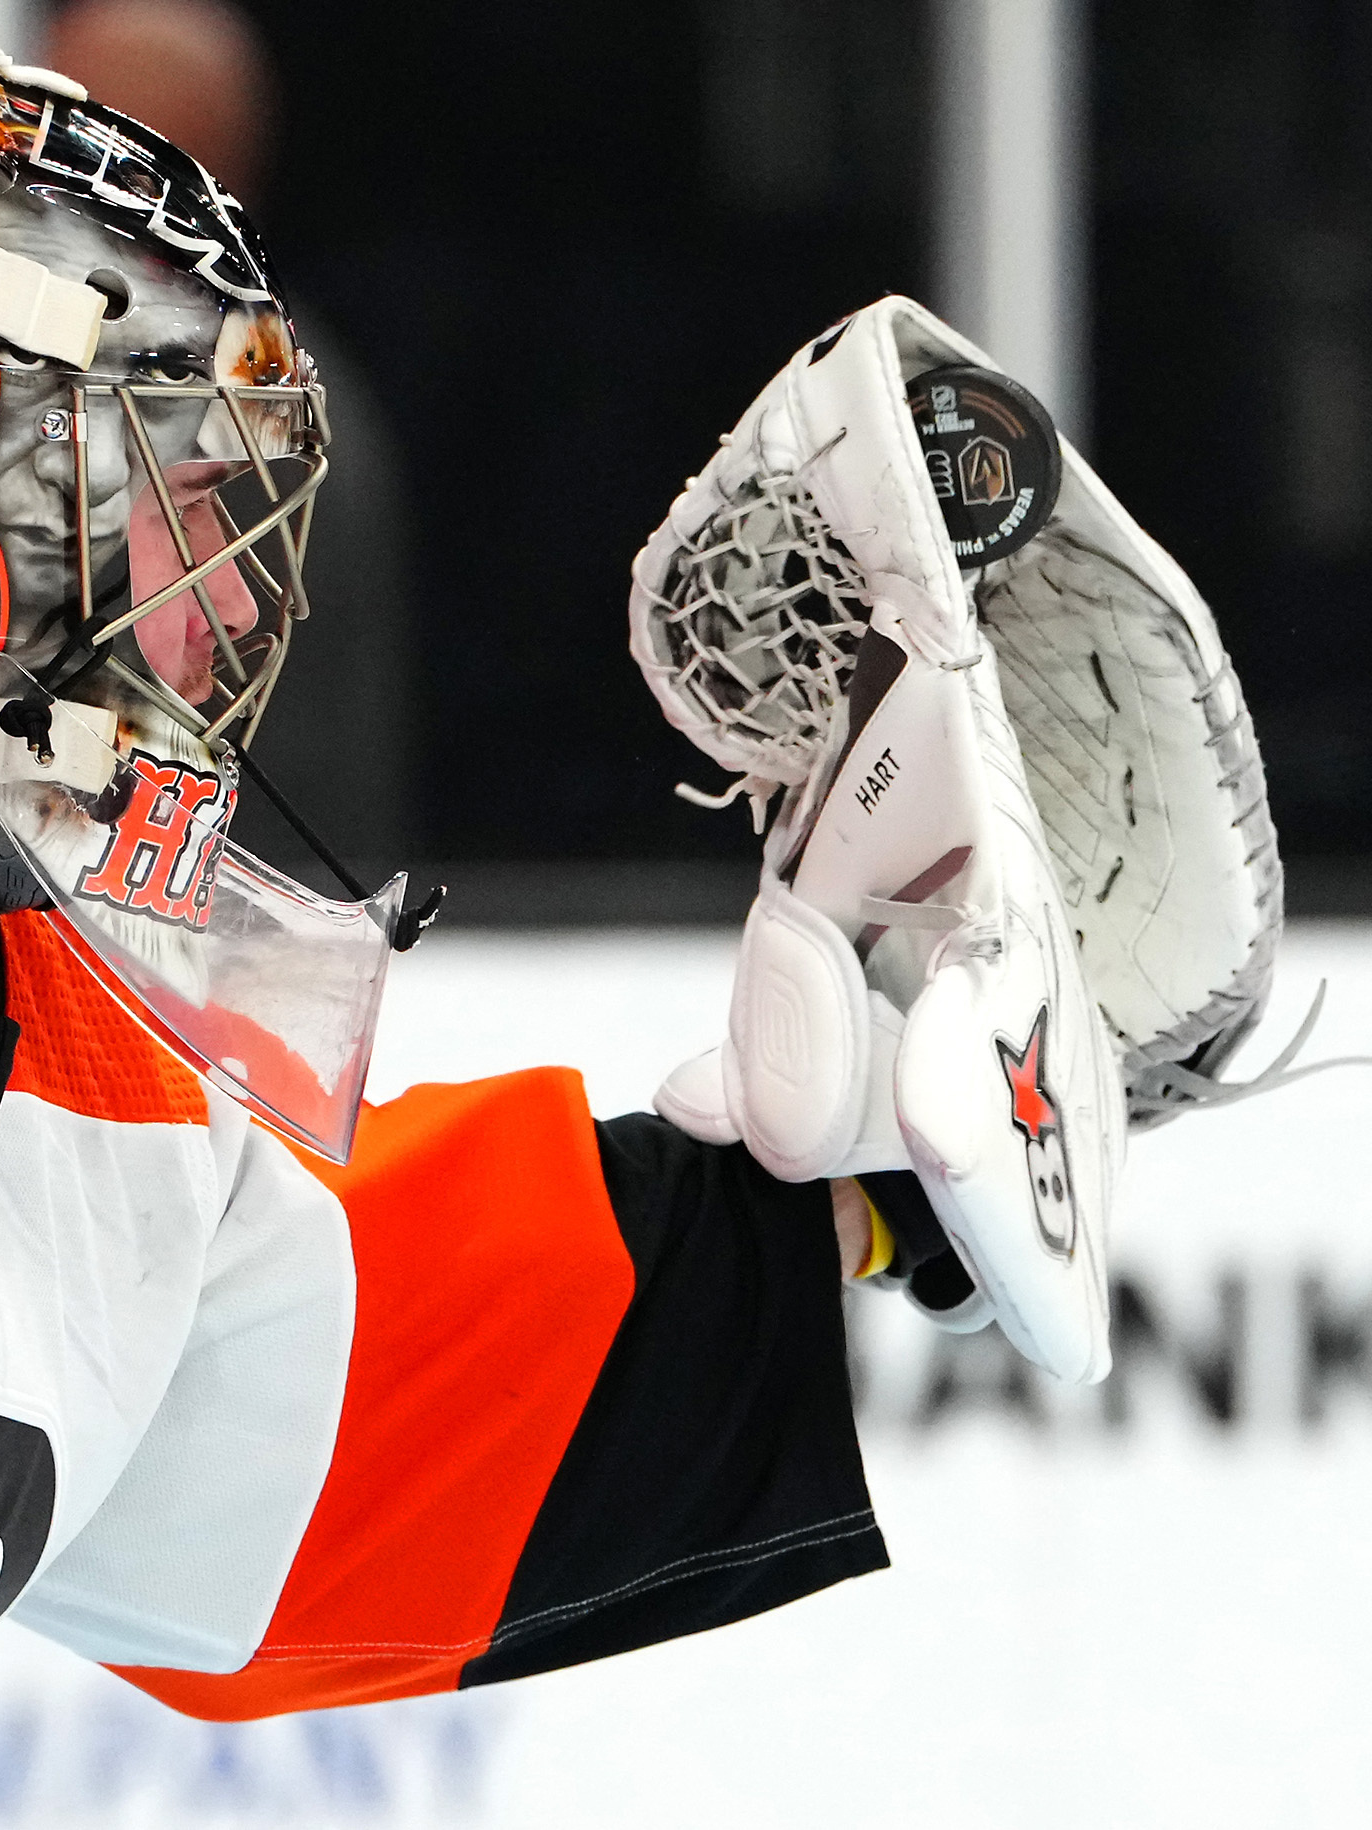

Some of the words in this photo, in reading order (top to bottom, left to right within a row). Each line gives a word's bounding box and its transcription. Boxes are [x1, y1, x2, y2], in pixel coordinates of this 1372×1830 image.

[999, 487, 1035, 538] VEGAS
[855, 747, 901, 816] HART
[847, 1268, 1372, 1428] ANK
